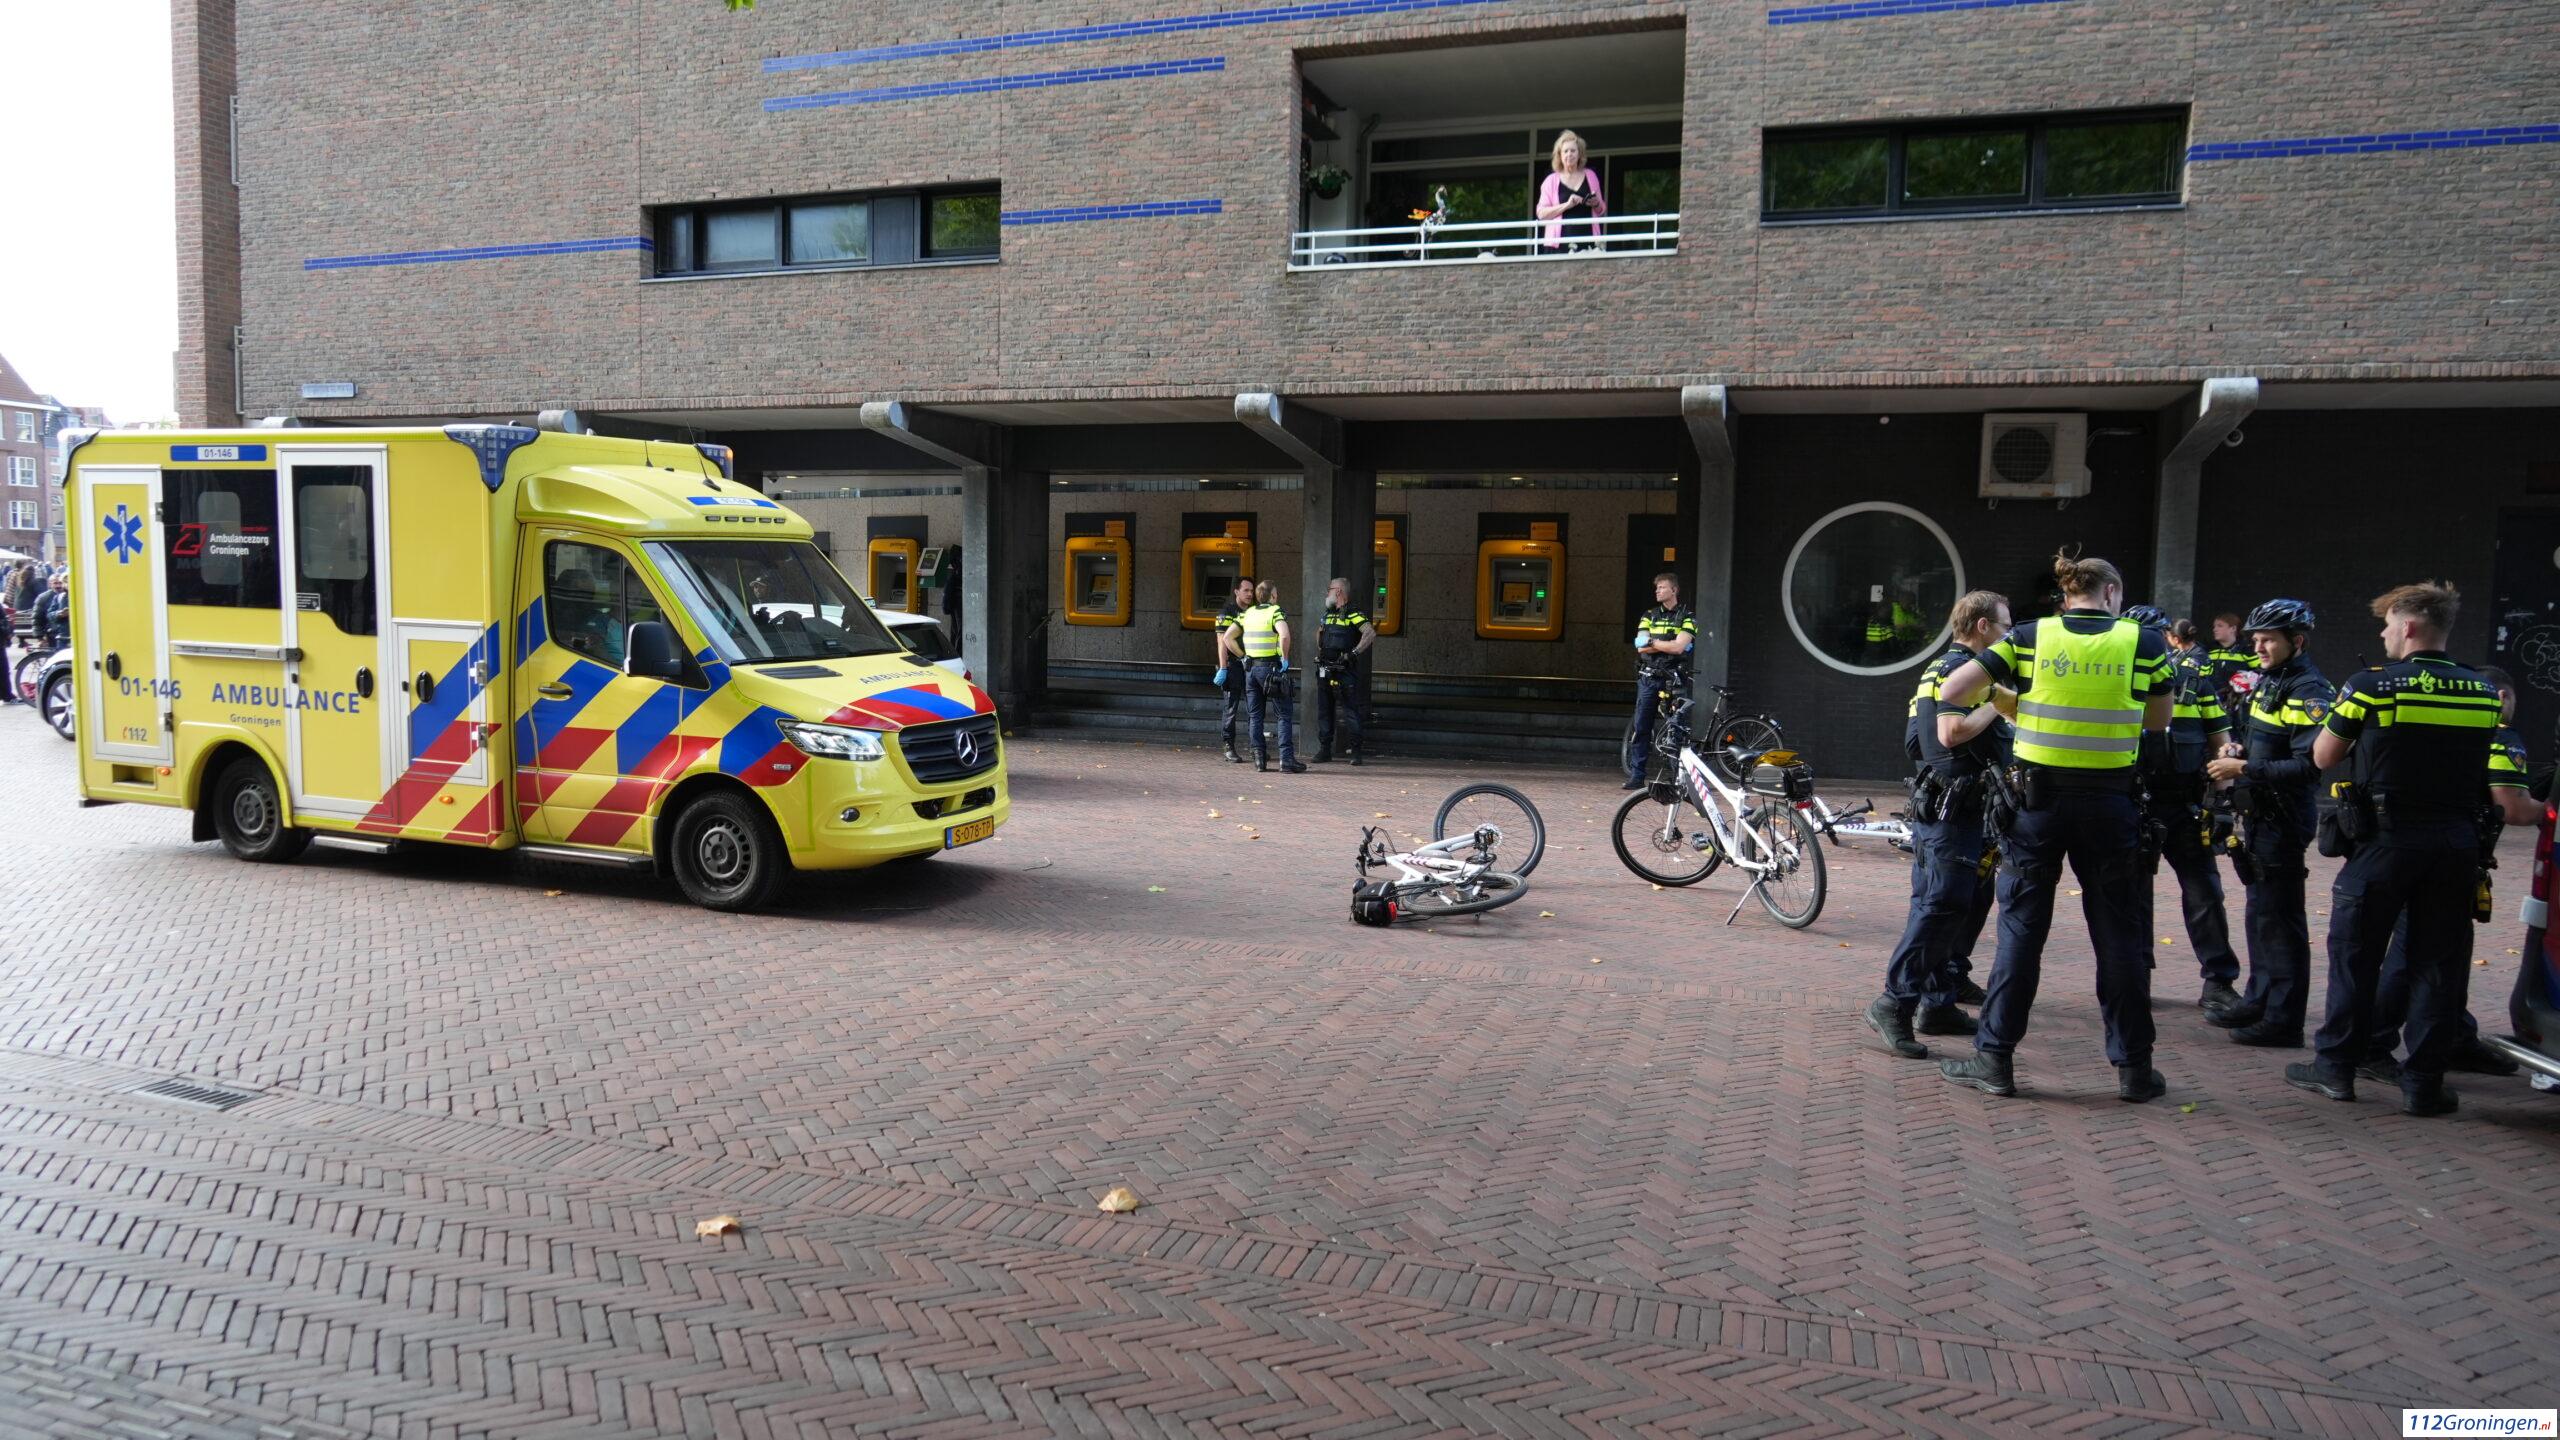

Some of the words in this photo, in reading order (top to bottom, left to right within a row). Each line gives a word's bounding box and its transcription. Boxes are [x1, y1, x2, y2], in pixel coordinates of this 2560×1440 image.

[204, 448, 232, 458] 01-146
[210, 533, 270, 546] Ambulancezorg
[210, 545, 249, 556] Groningen
[2041, 650, 2125, 677] POLITIE
[860, 670, 937, 684] AMBULANCE
[2408, 670, 2483, 693] POLITIE
[121, 677, 182, 699] 01-146
[211, 683, 360, 713] AMBULANCE
[230, 713, 281, 727] Groningen
[955, 821, 991, 843] S-078-TP
